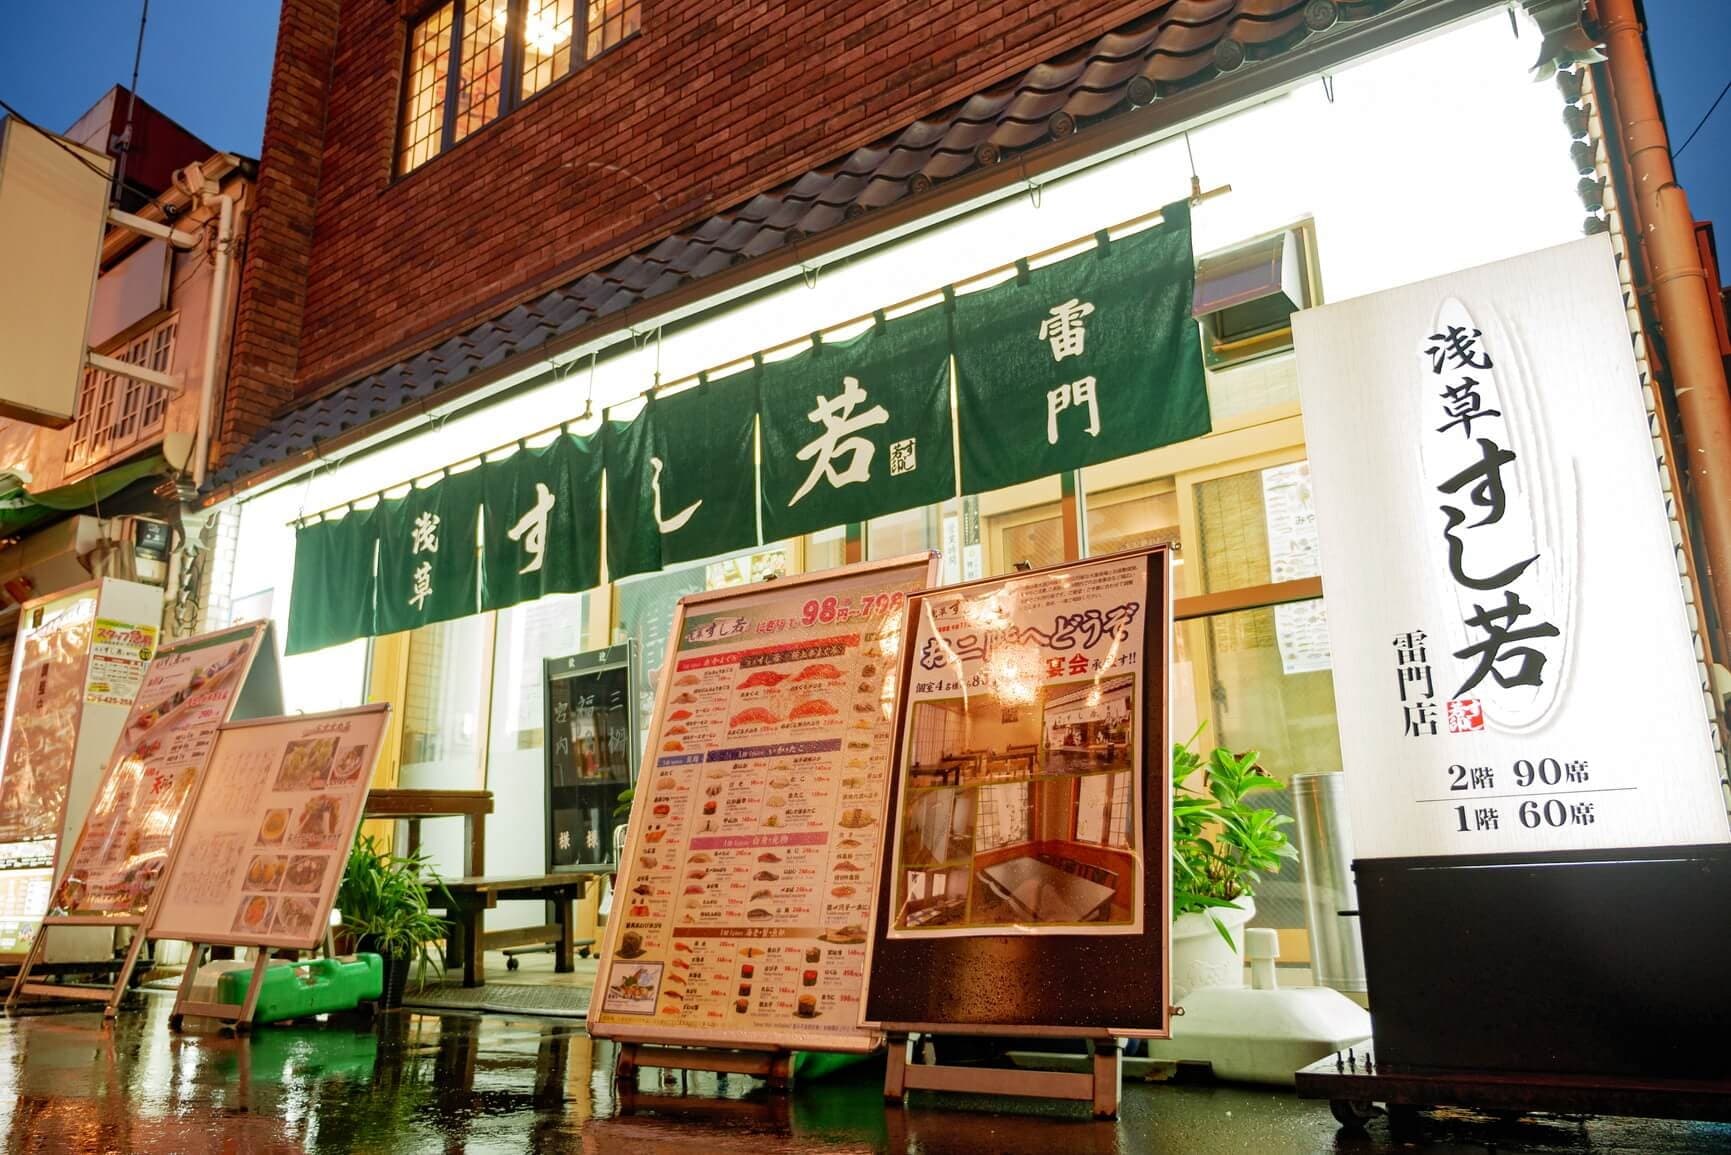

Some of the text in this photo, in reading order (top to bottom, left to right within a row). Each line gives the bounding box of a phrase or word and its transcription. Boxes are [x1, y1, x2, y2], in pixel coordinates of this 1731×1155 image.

[1039, 298, 1100, 444] 雷門
[409, 511, 440, 611] 浅草
[1392, 630, 1439, 737] 雷門店
[1448, 758, 1589, 791] 2階 90席
[1454, 799, 1595, 832] 1階 60席
